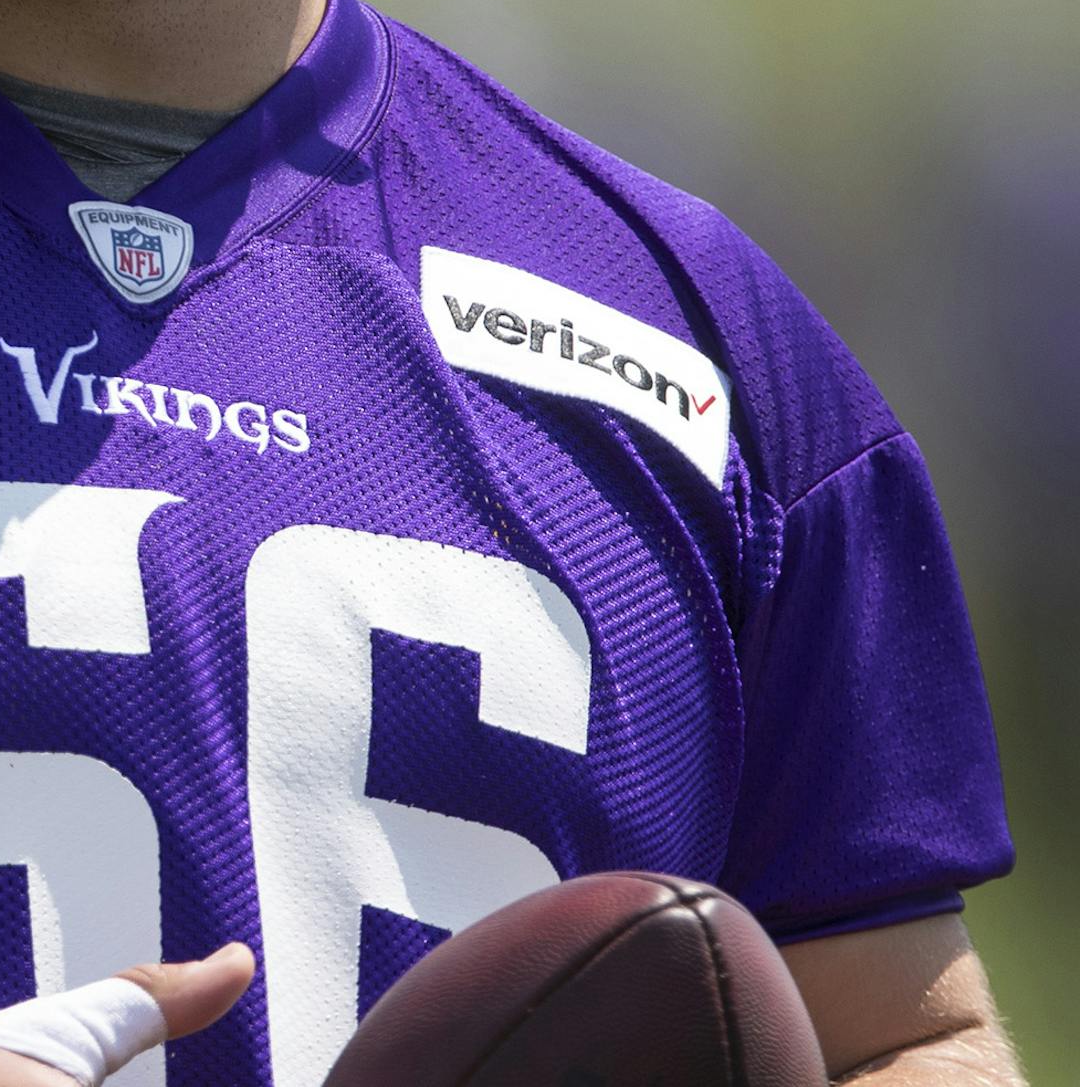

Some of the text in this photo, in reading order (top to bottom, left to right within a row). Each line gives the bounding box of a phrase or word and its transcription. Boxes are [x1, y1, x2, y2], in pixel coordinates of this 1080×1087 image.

[88, 212, 179, 237] EQUIPMENT
[118, 248, 161, 279] NFL
[442, 294, 690, 421] verizon
